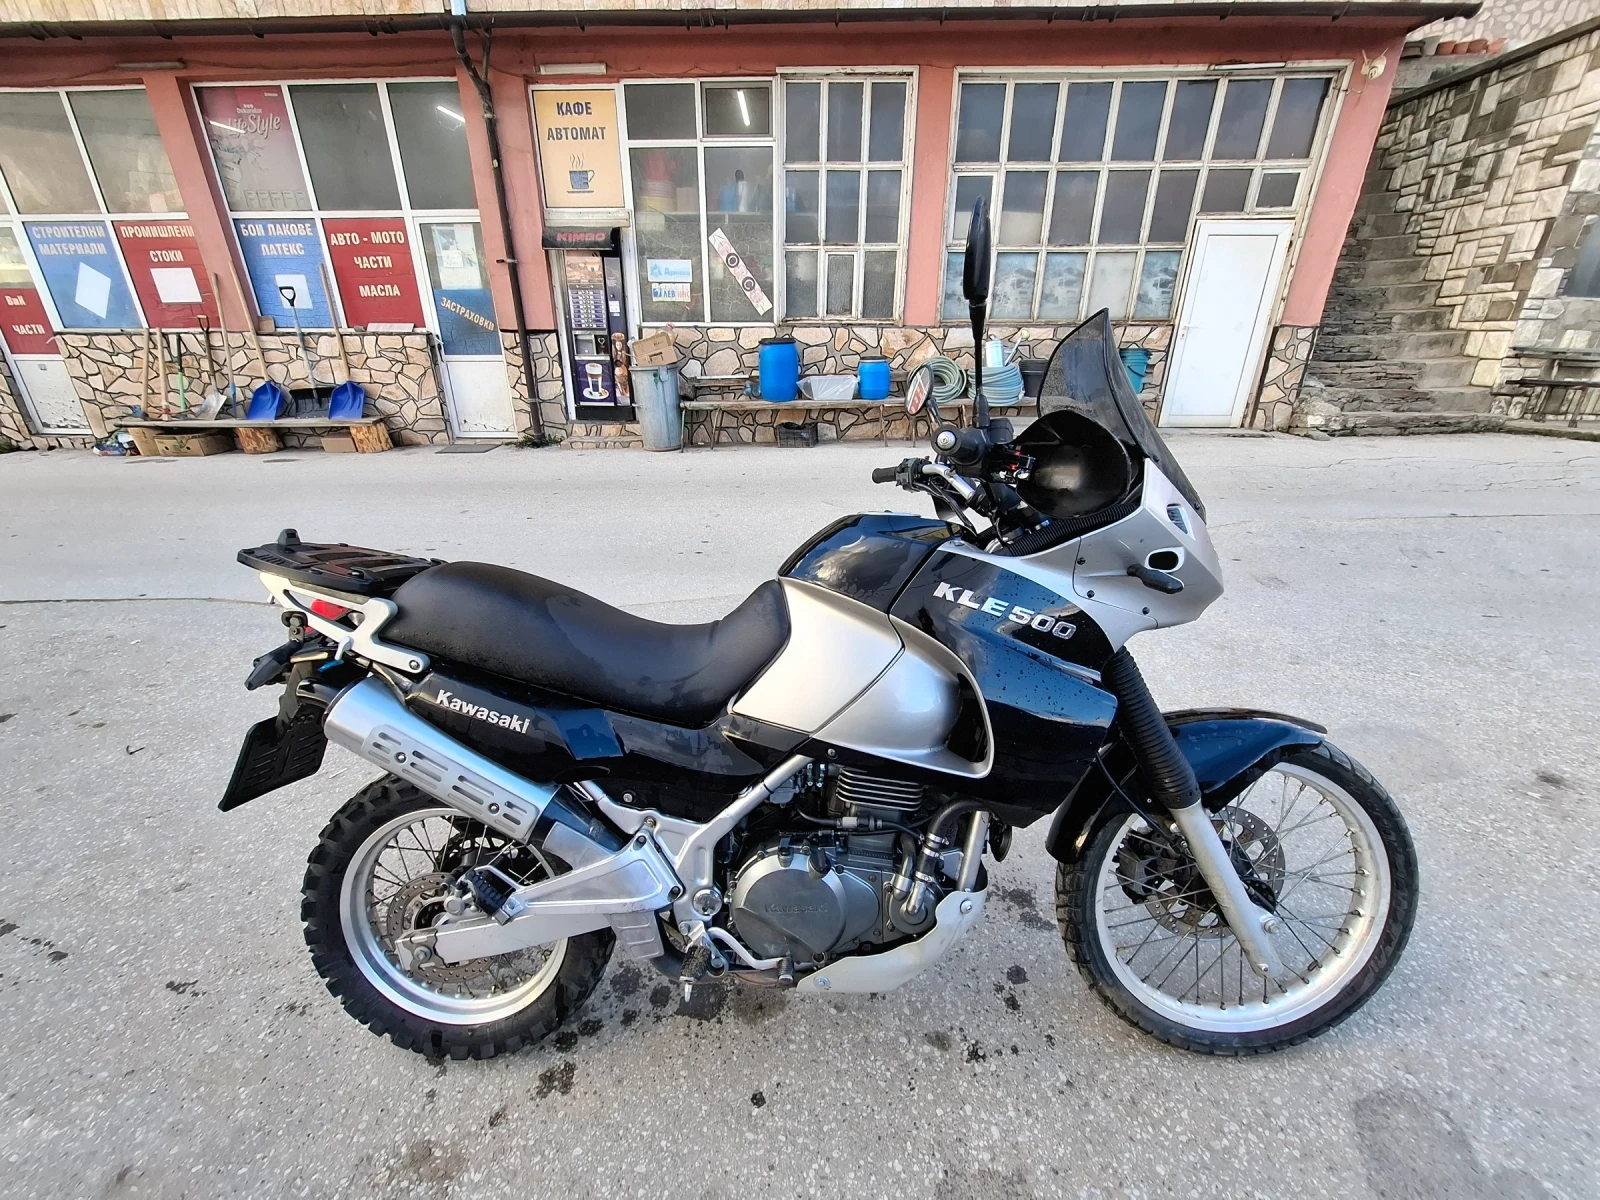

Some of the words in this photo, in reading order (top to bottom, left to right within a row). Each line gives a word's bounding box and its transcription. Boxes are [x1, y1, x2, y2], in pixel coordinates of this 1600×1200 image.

[556, 101, 592, 116] КАФЕ
[547, 126, 606, 141] АВТОМАТ
[32, 225, 106, 239] СТРОИТЕЛНИ
[120, 225, 195, 238] ПРОМИШЛЕНИ
[240, 223, 265, 237] БОИ
[268, 223, 313, 237] ЛАКОВЕ
[556, 232, 607, 242] KIMBO
[330, 232, 360, 246] АВТО
[371, 231, 405, 244] МОТО
[38, 242, 107, 256] МАТЕРИАЛИ
[149, 249, 184, 262] СТОКИ
[261, 243, 305, 256] ЛАТЕКС
[353, 255, 393, 269] ЧАСТИ
[359, 284, 401, 297] МАСЛА
[663, 290, 676, 298] ЛЕВ
[440, 296, 495, 332] ЗАСТРАХОВКИ
[12, 323, 46, 335] ЧАСТИ
[436, 689, 530, 734] Kawasaki
